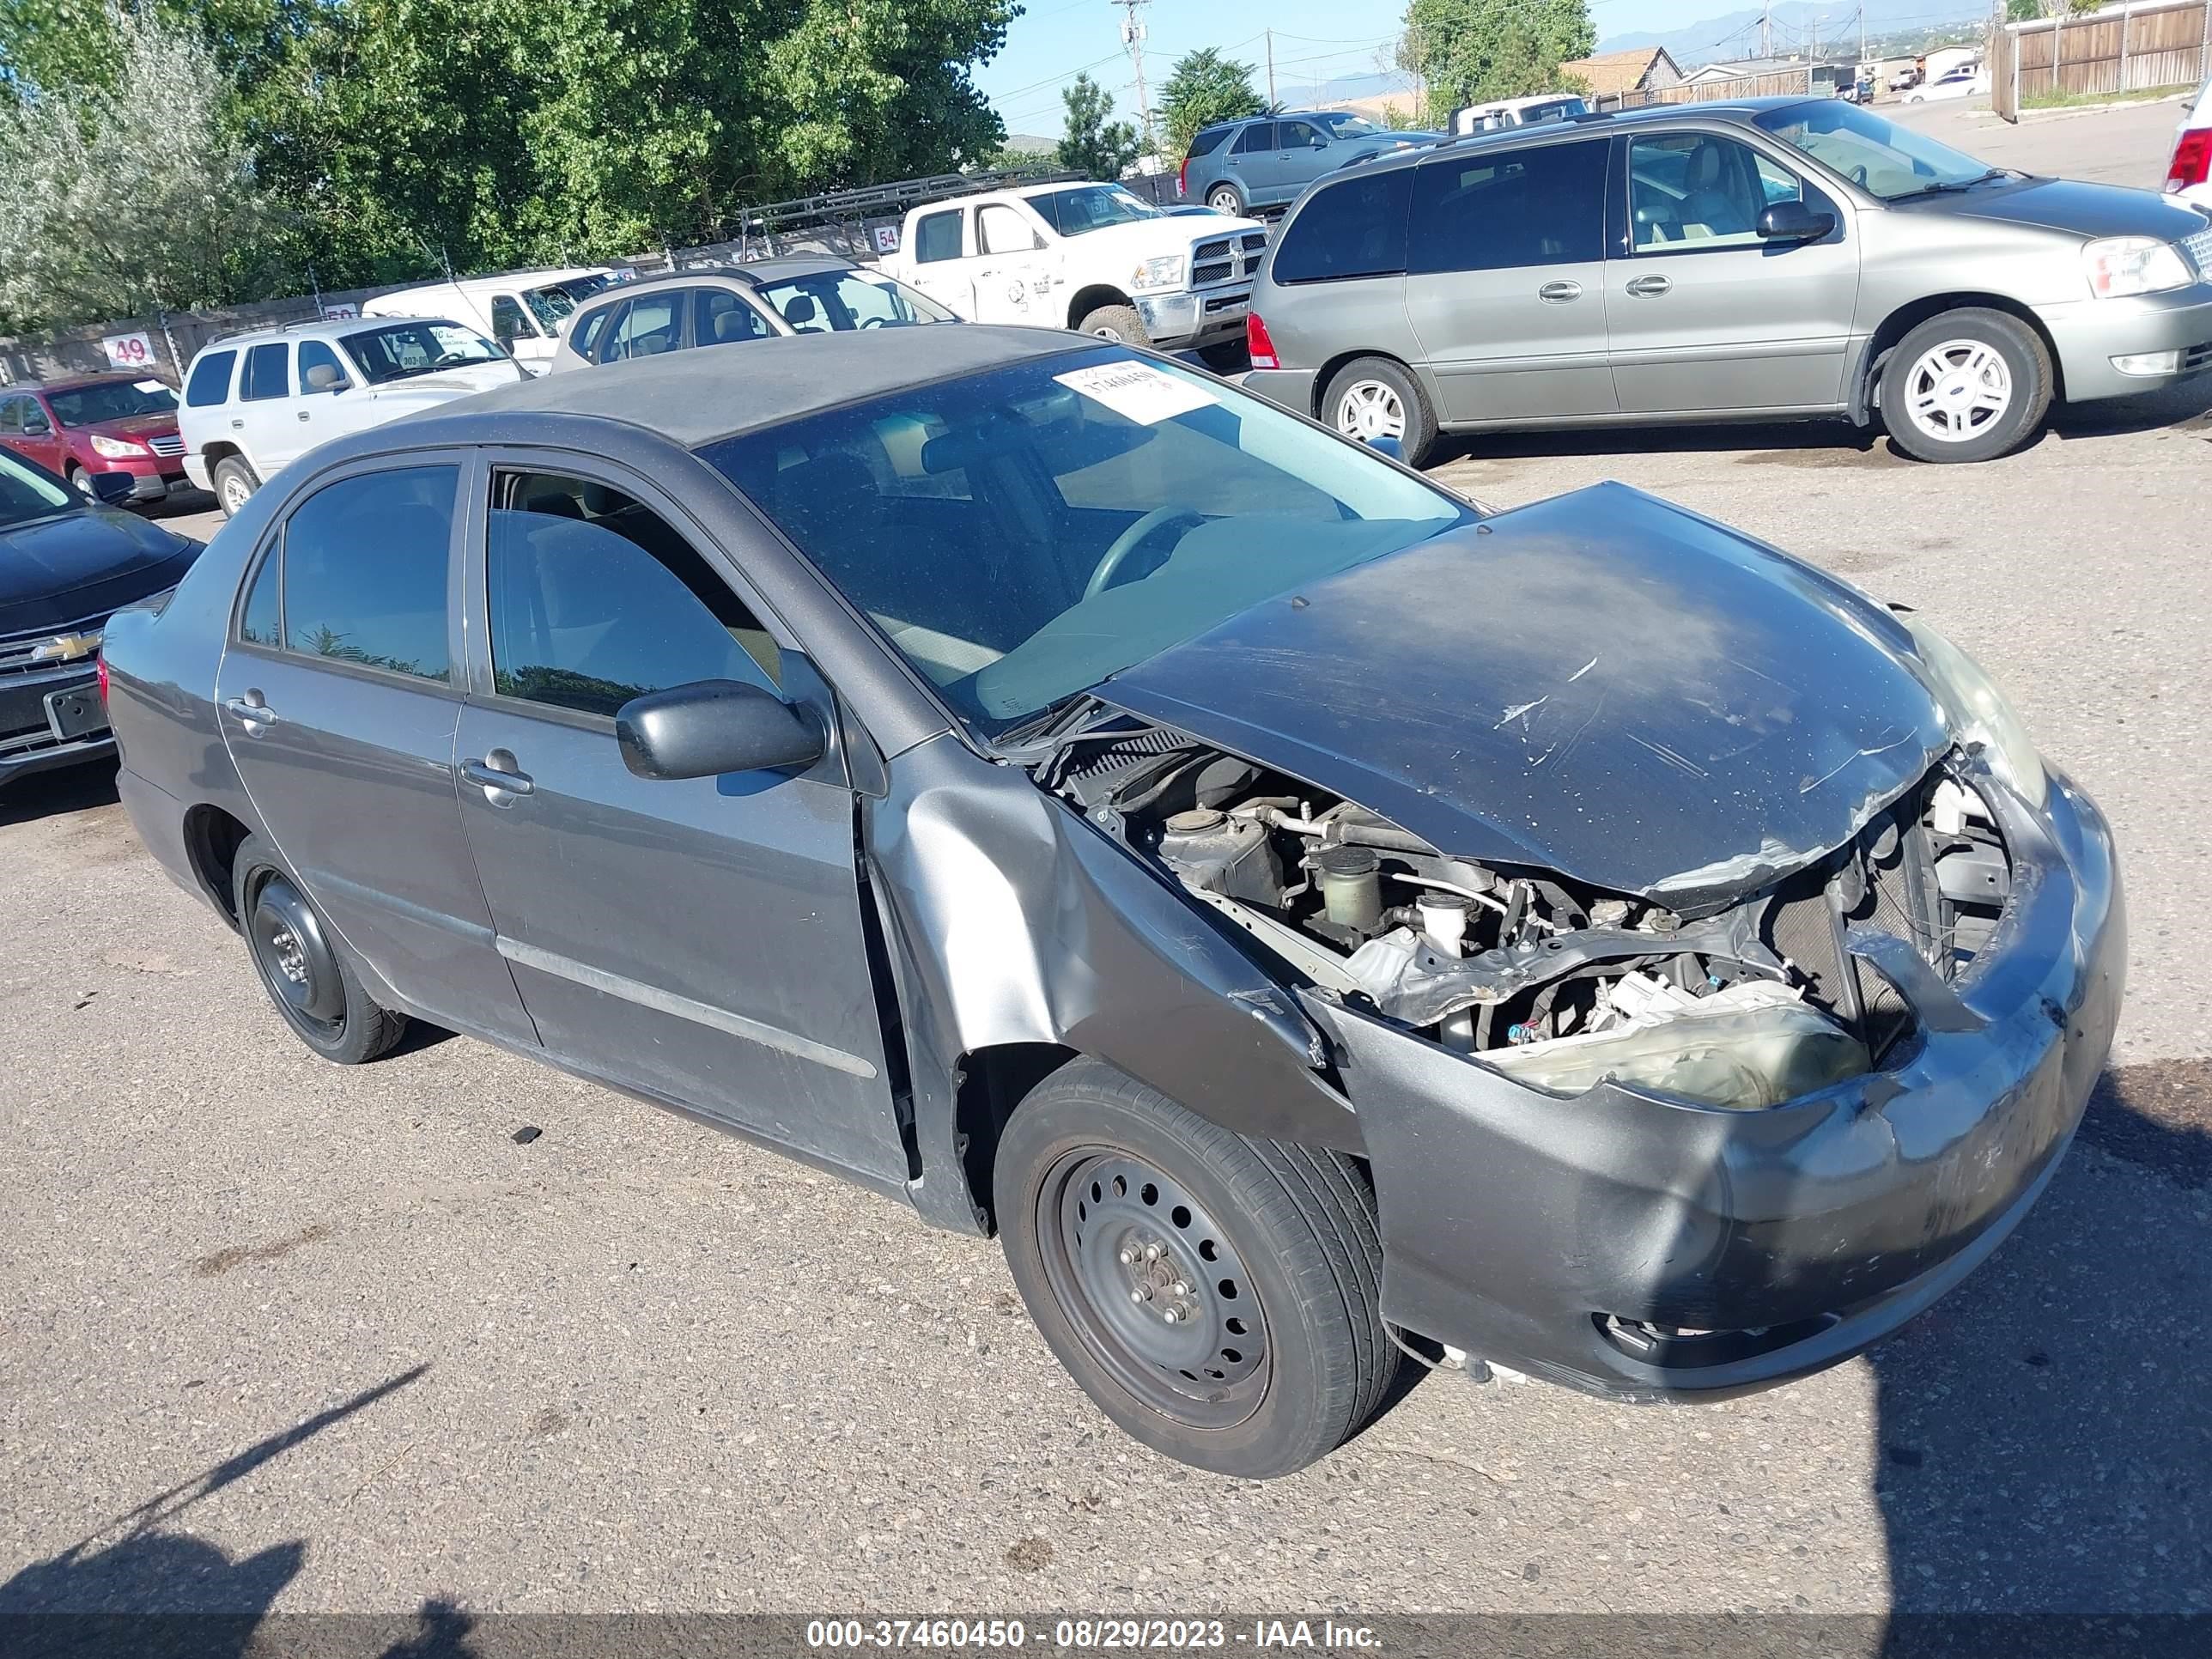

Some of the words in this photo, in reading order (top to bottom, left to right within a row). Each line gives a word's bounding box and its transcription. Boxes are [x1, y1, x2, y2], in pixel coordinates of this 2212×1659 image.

[879, 229, 896, 247] 54
[117, 338, 145, 362] 49
[1084, 371, 1158, 394] 37460450
